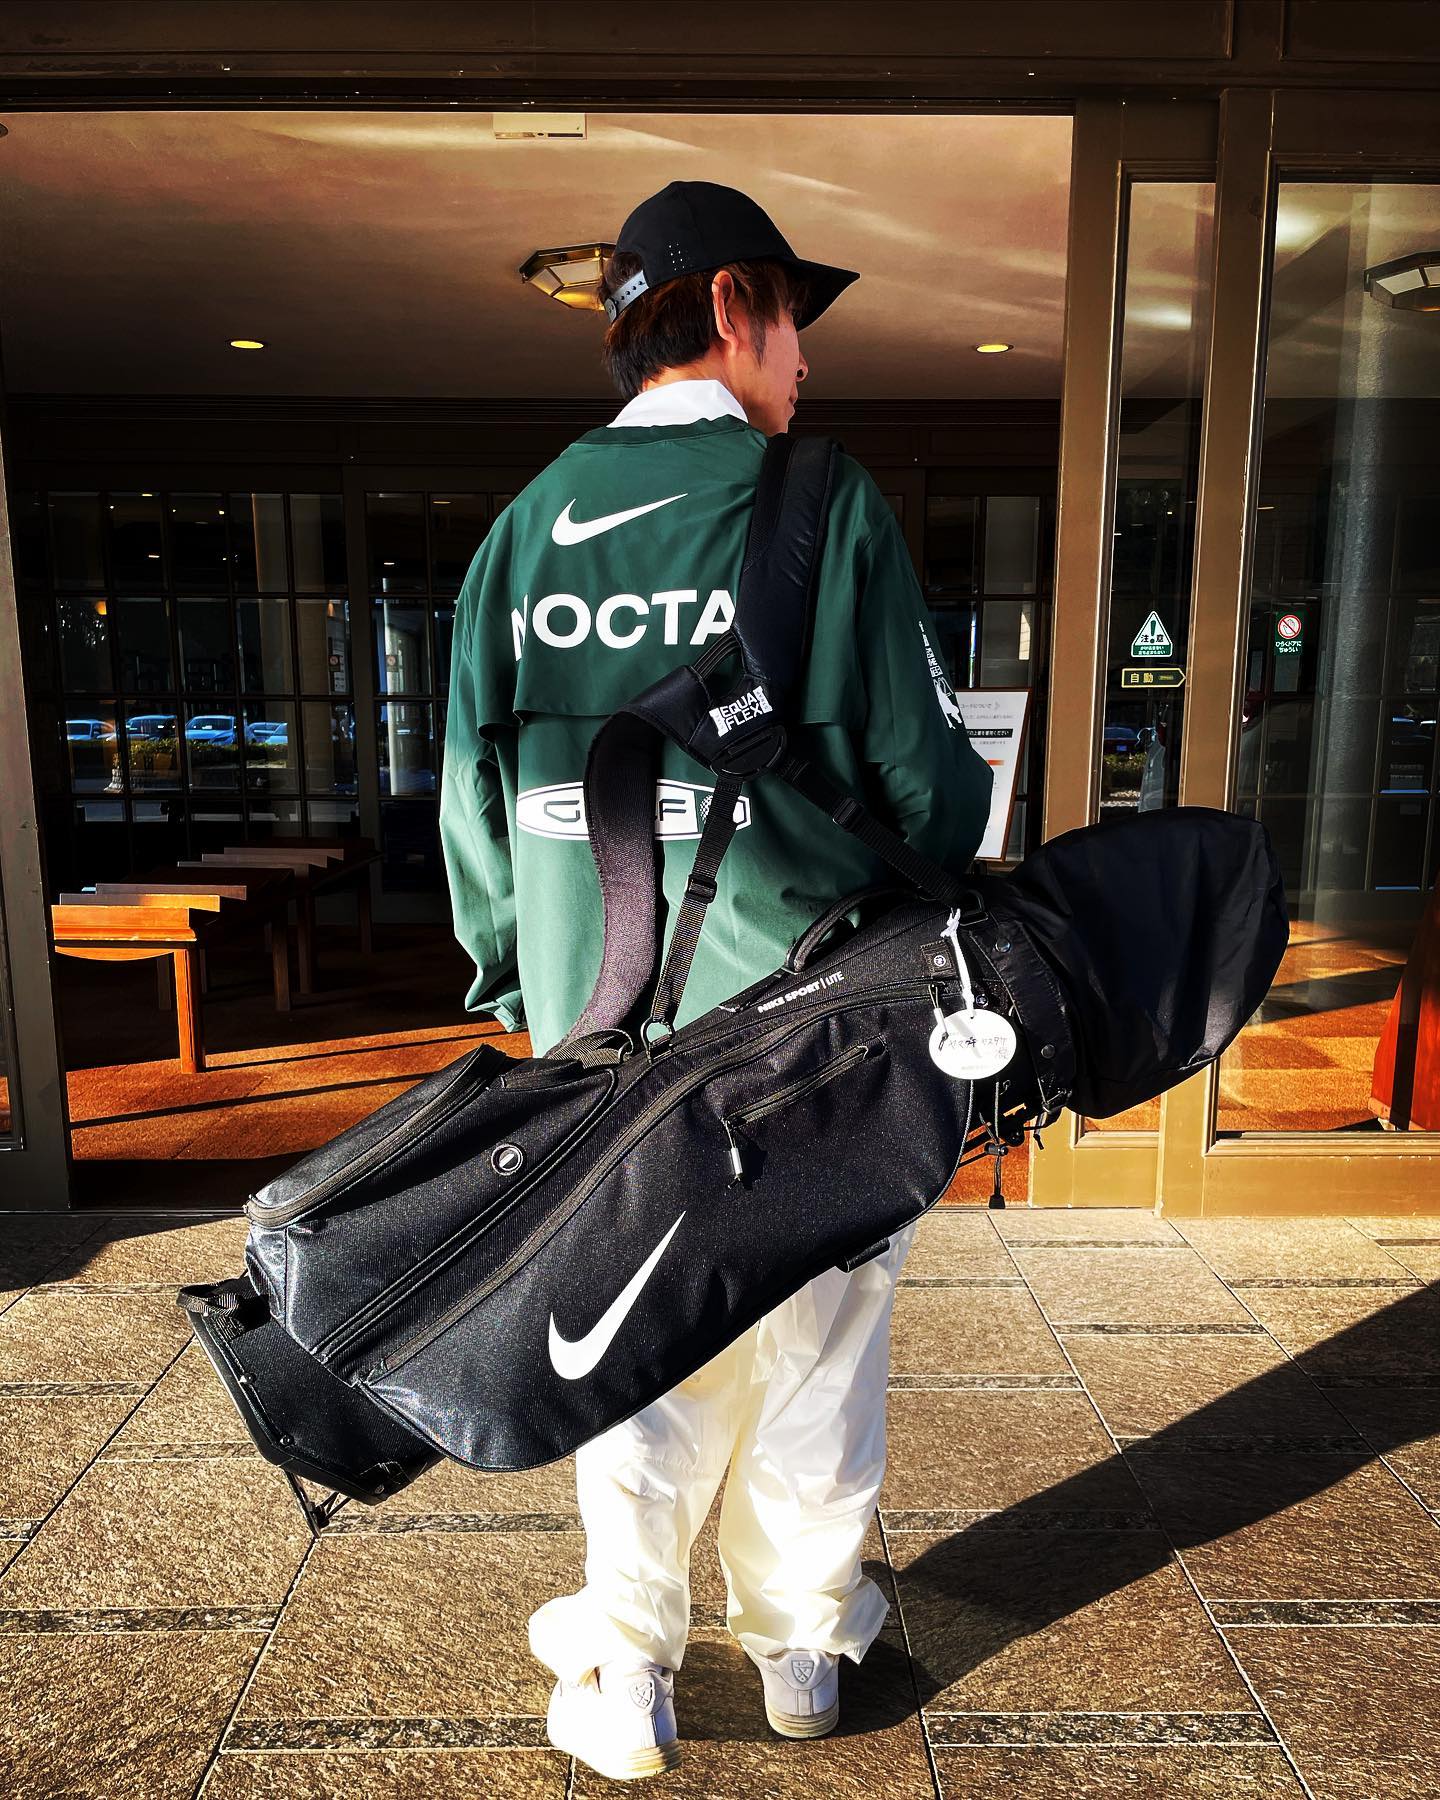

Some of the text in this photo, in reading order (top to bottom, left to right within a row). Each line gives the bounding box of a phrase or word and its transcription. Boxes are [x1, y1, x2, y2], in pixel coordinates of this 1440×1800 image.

[511, 589, 736, 662] NOCTA
[1130, 672, 1154, 683] 自動
[720, 692, 758, 718] EQUA
[725, 702, 762, 731] FLEX
[757, 970, 845, 1013] NIKE SPORT LITE
